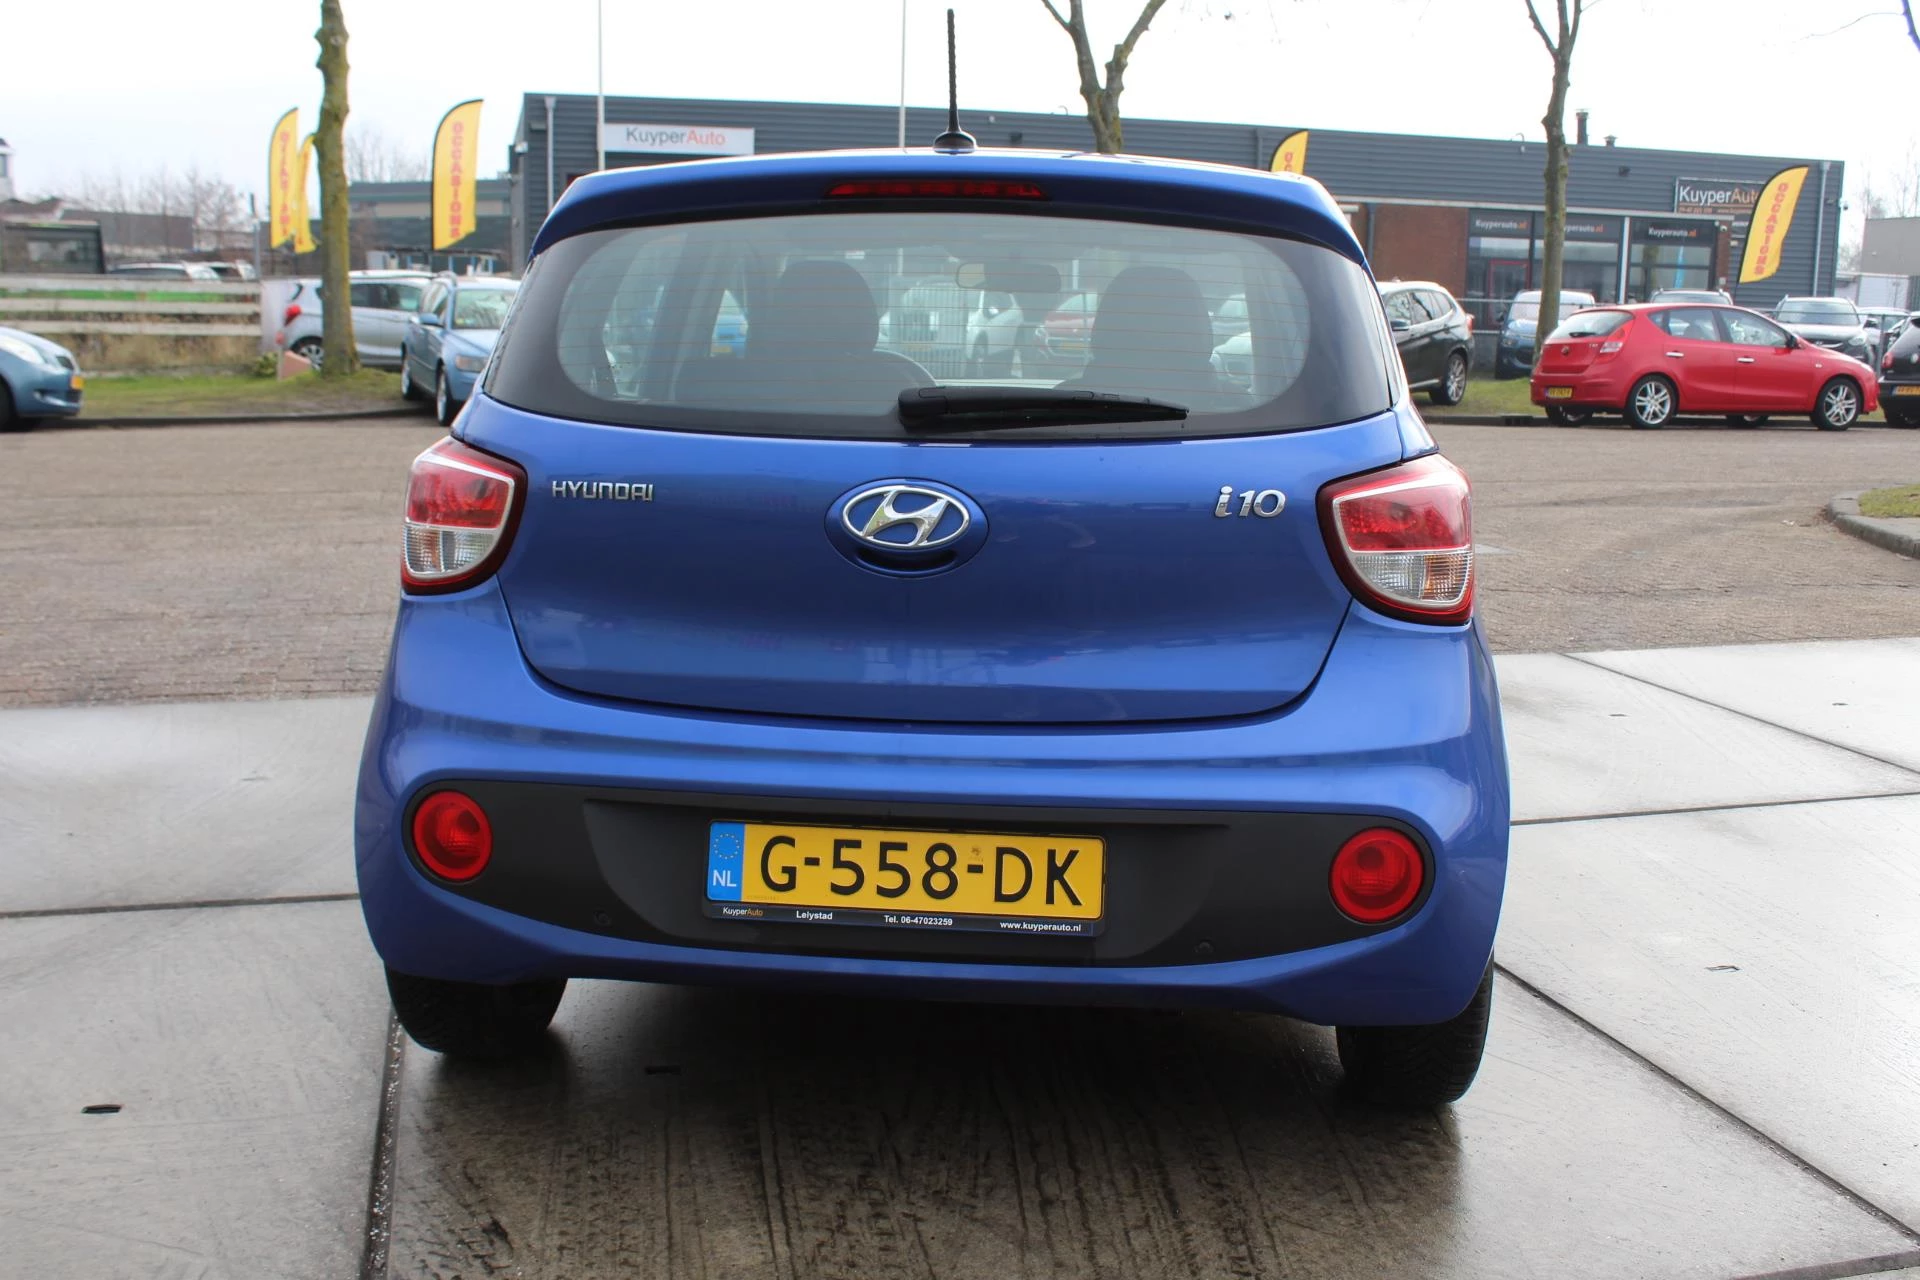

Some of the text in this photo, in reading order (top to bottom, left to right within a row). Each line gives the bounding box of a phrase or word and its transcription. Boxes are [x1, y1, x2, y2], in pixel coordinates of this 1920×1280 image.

[626, 127, 726, 147] KuyperAuto
[1680, 186, 1759, 206] KuyperAut
[1754, 182, 1789, 275] OCCASIONS
[552, 480, 653, 501] HYUNDAI
[1214, 485, 1286, 518] i10
[712, 835, 1082, 906] NL G-558-DK
[722, 907, 1081, 933] KuyperAuto Lelystad Tel. 06-47023259 www.kuyperauto.nl
